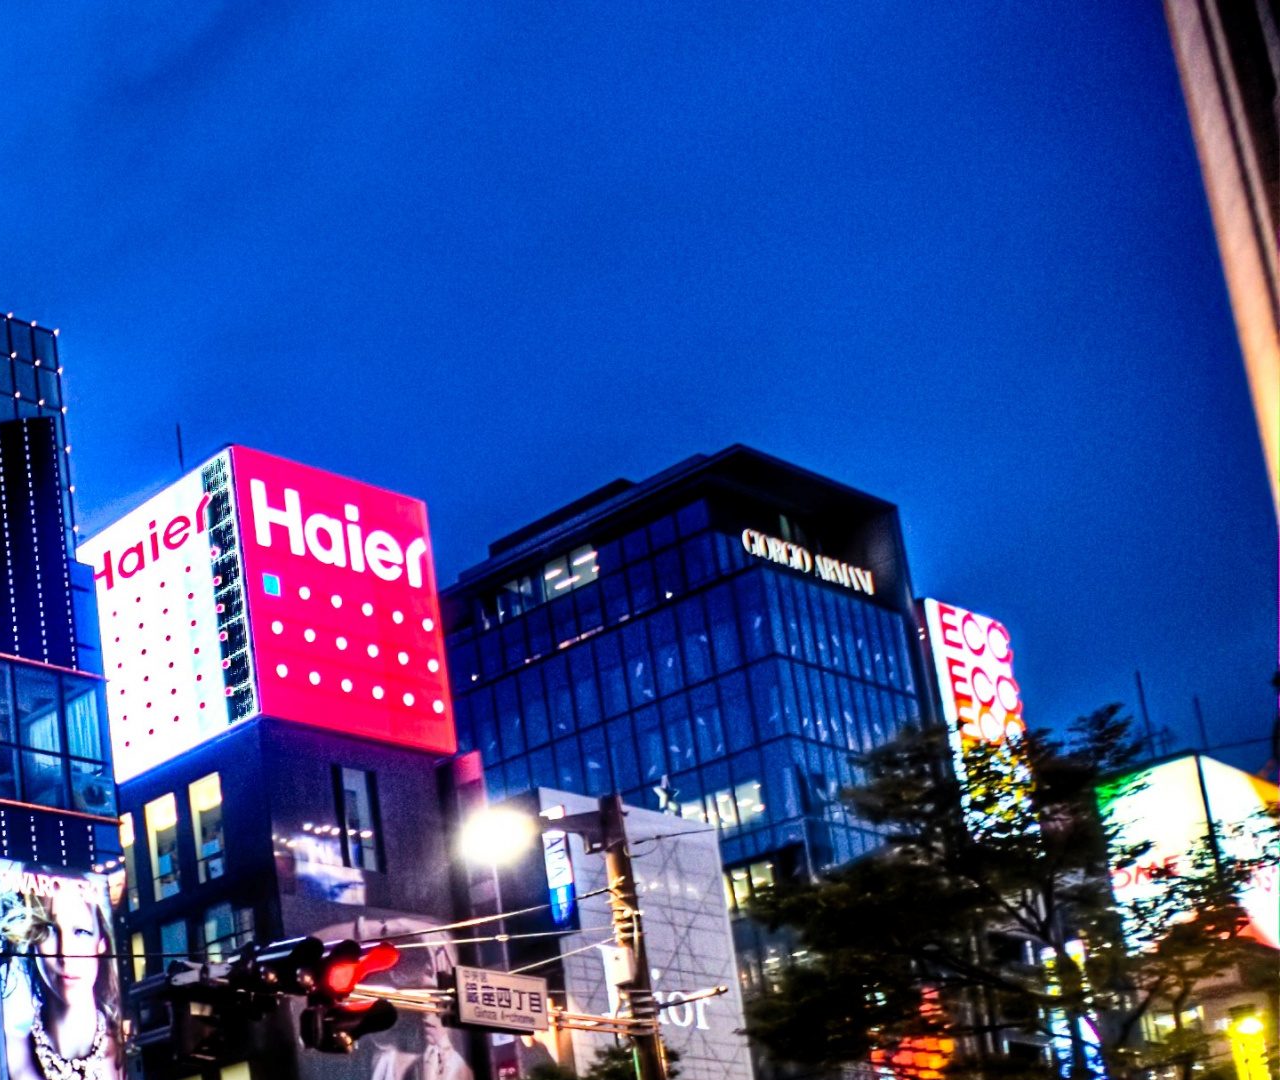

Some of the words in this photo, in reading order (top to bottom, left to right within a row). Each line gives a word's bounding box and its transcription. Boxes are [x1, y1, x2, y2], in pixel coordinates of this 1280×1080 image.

[249, 478, 428, 589] Haier
[741, 528, 813, 574] GIORGIO
[464, 982, 542, 1013] 銀座四丁目
